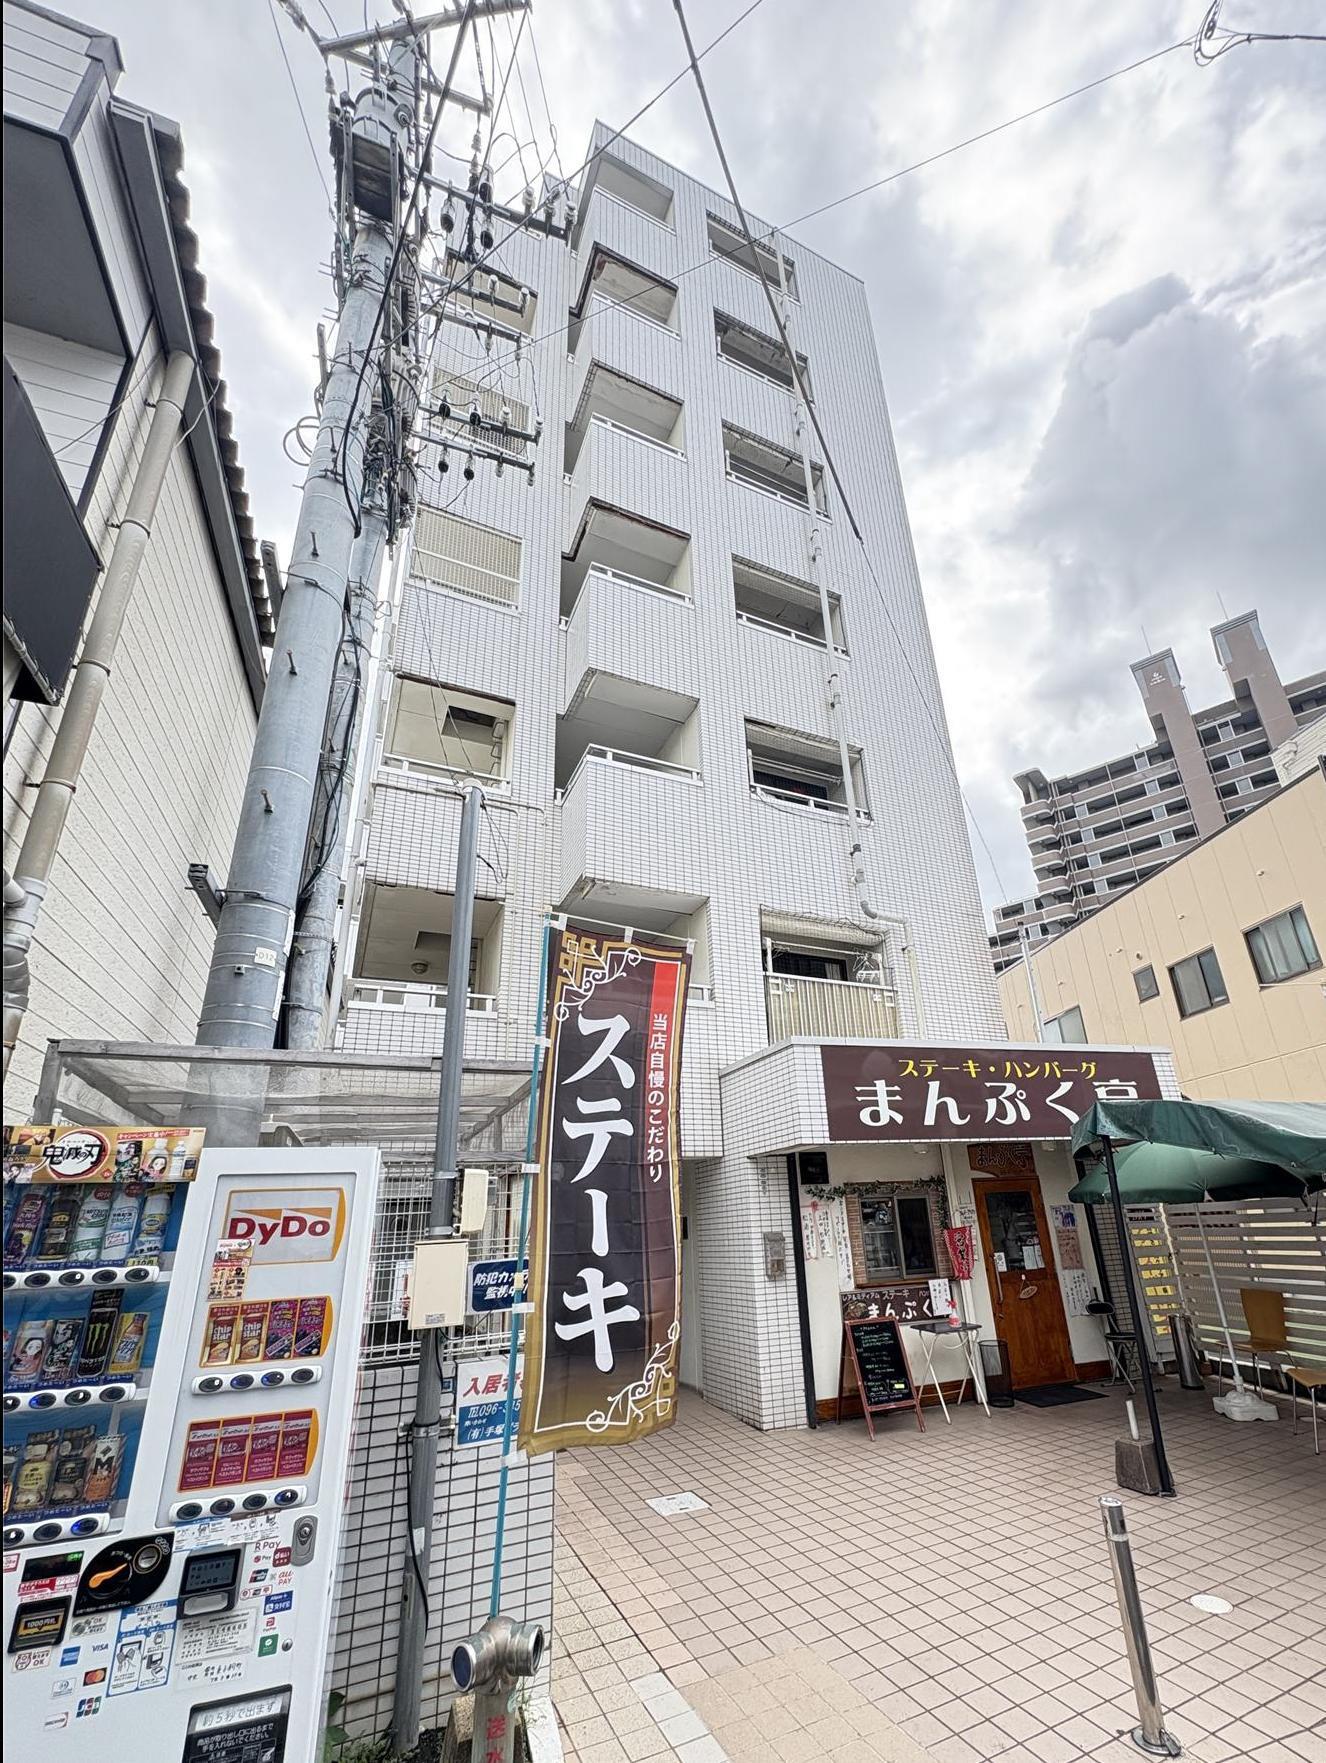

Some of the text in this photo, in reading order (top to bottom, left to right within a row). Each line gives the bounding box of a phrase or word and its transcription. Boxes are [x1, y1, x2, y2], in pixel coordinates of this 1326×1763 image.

[899, 1058, 1097, 1080] ステーキ・ハンバーグ
[647, 1013, 668, 1183] 当店自慢のこだわり
[43, 1144, 103, 1165] 鬼滅の刃
[555, 1013, 641, 1373] ステーキ
[228, 1216, 331, 1245] DyDo
[882, 1289, 910, 1300] ステーキ
[263, 1540, 281, 1550] Pay
[91, 1643, 109, 1652] VISA
[76, 1696, 102, 1718] JCB
